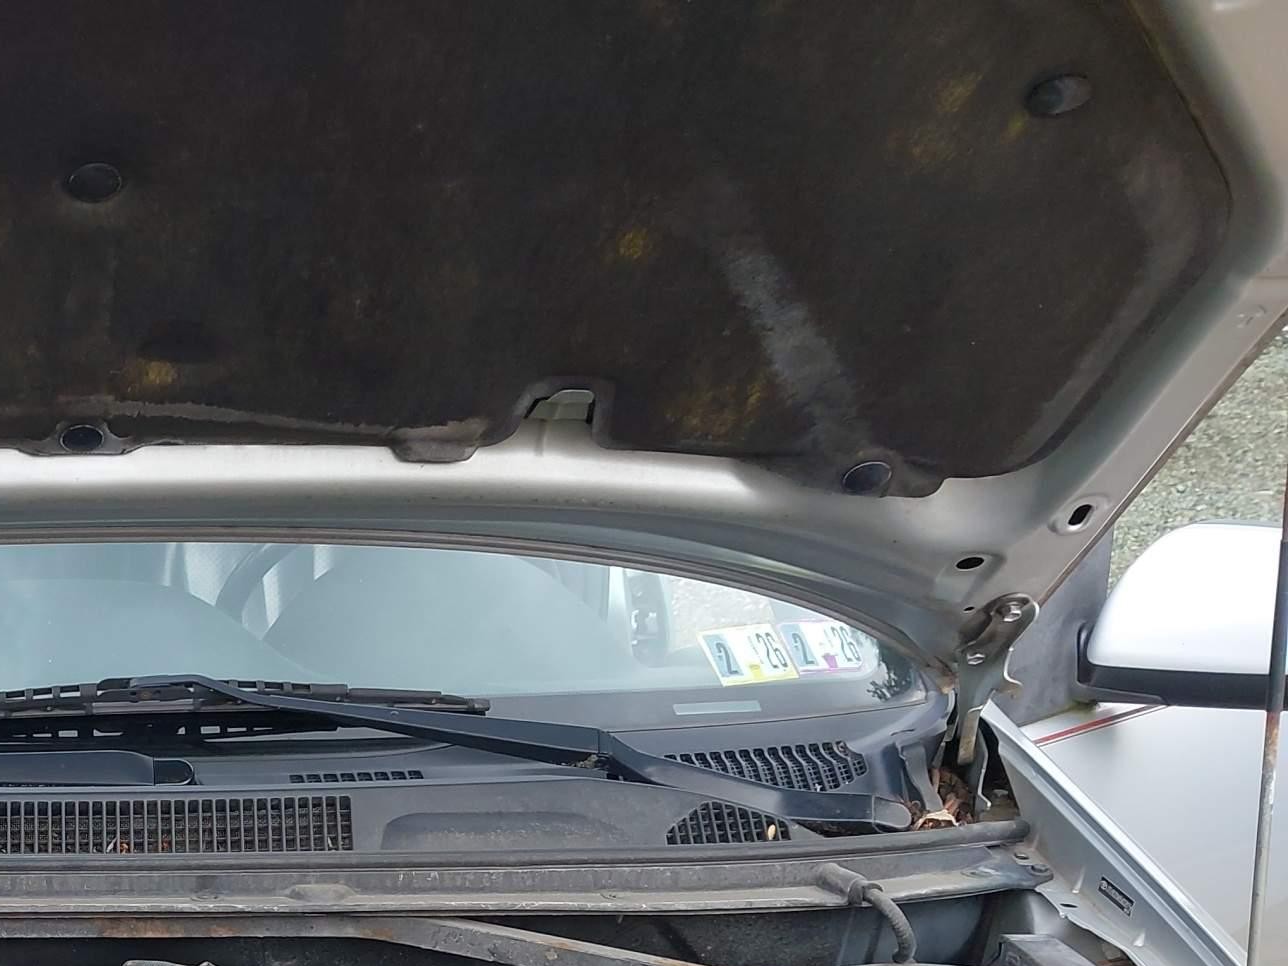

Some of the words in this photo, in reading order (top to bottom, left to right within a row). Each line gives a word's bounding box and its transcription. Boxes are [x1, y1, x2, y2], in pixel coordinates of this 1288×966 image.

[715, 642, 739, 675] 2
[755, 632, 788, 669] 26
[791, 632, 815, 665] 2
[830, 626, 861, 662] 26
